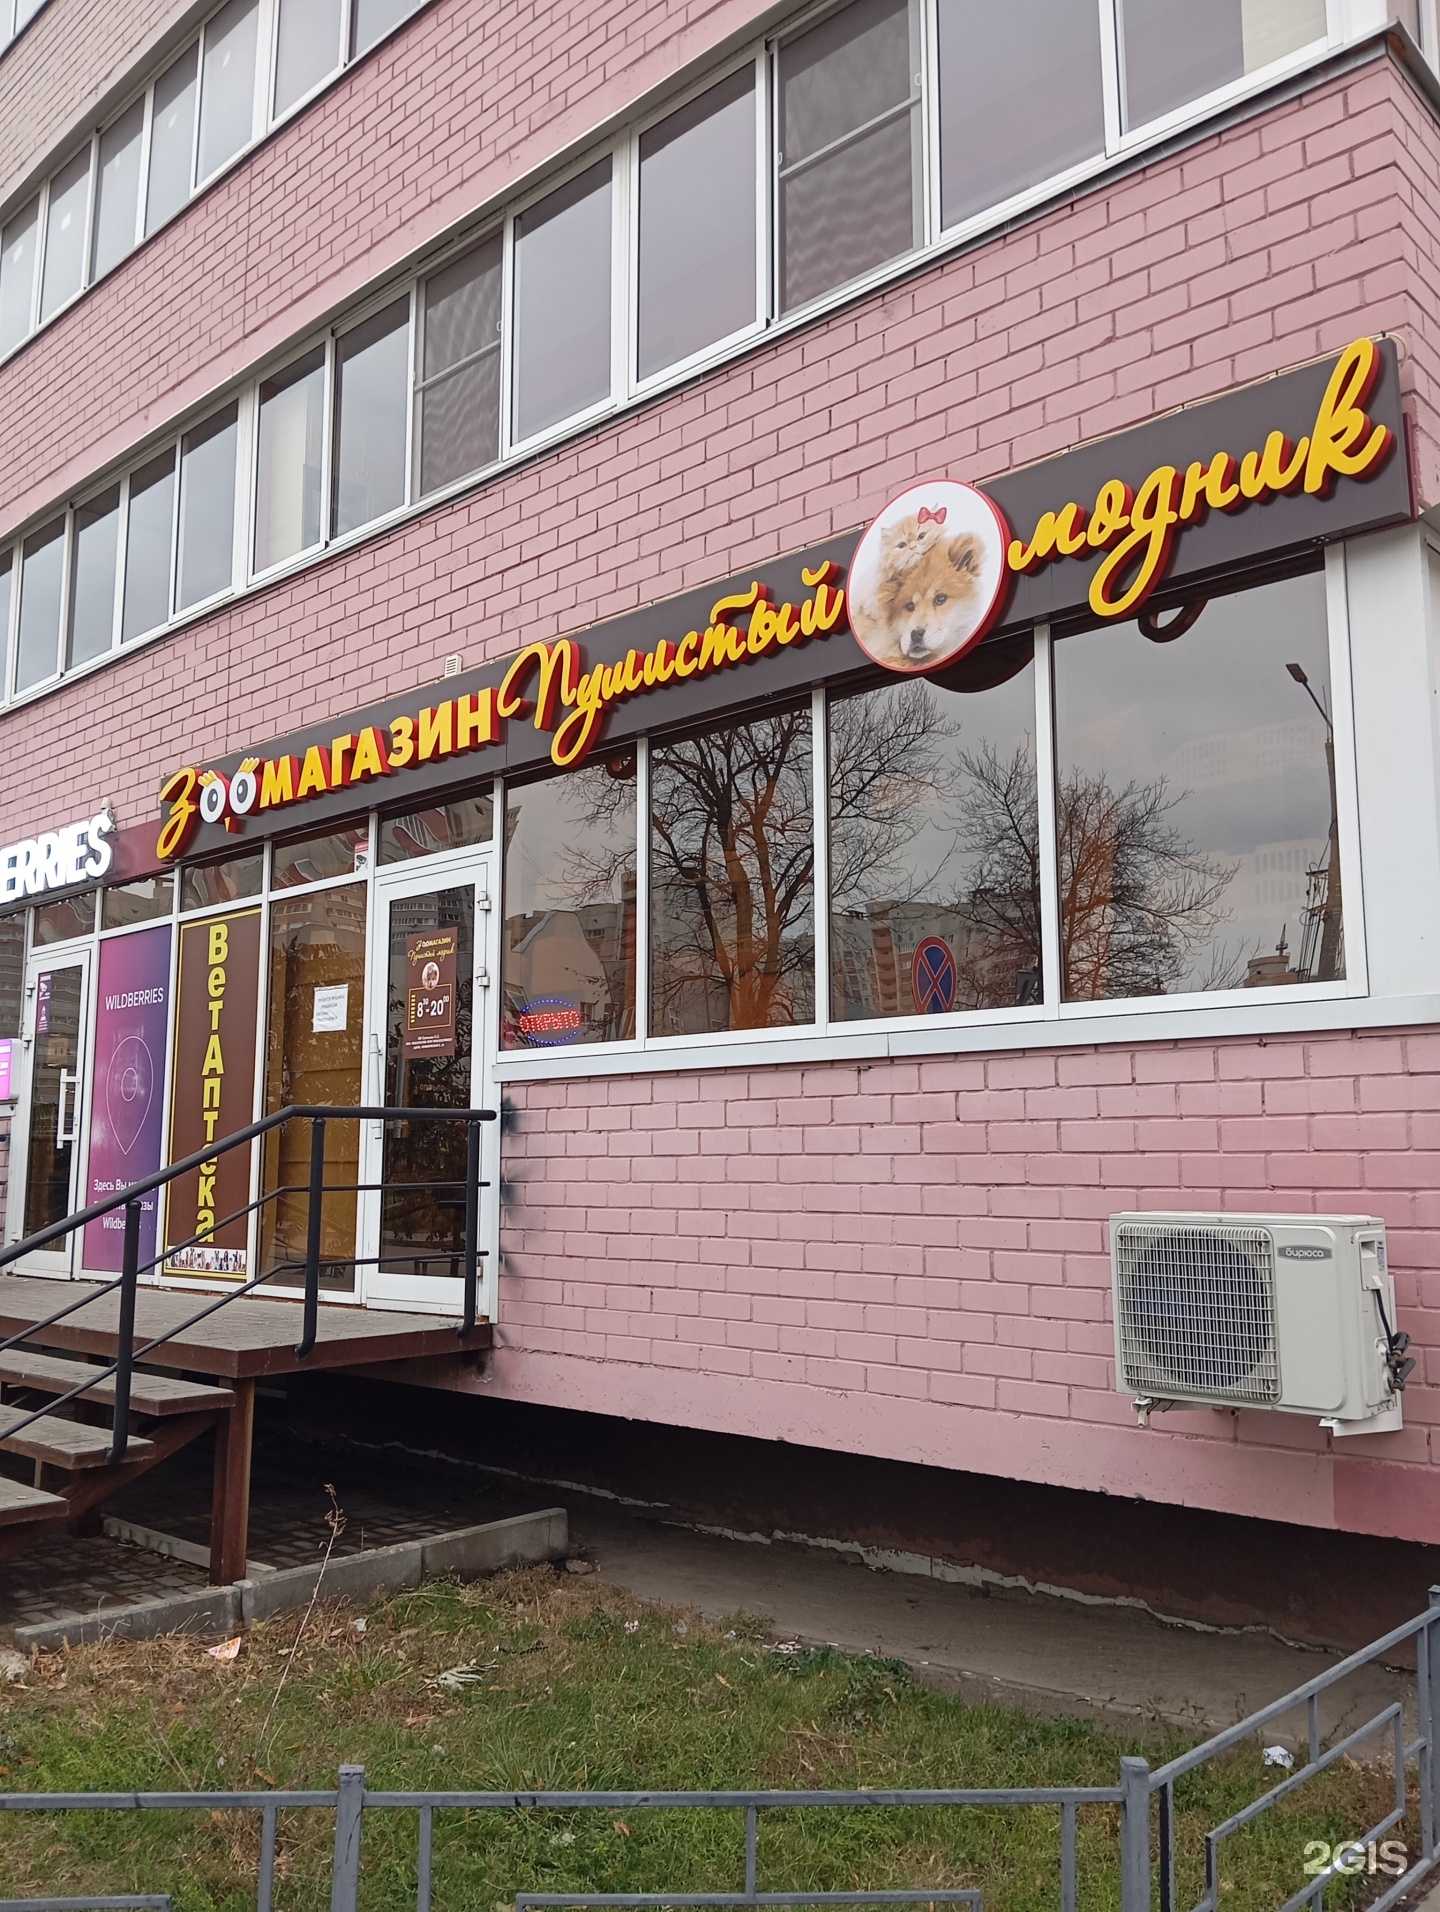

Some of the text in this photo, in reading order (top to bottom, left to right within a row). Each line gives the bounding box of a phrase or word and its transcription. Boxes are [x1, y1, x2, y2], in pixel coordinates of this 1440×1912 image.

[496, 560, 847, 767] Пушистый
[1007, 337, 1389, 617] модник
[0, 813, 112, 903] ERRIES
[105, 987, 164, 1010] WILDBERRIES
[520, 1009, 580, 1033] ОТКРЫТО
[93, 1179, 115, 1192] Здесь
[115, 1179, 127, 1191] Вы
